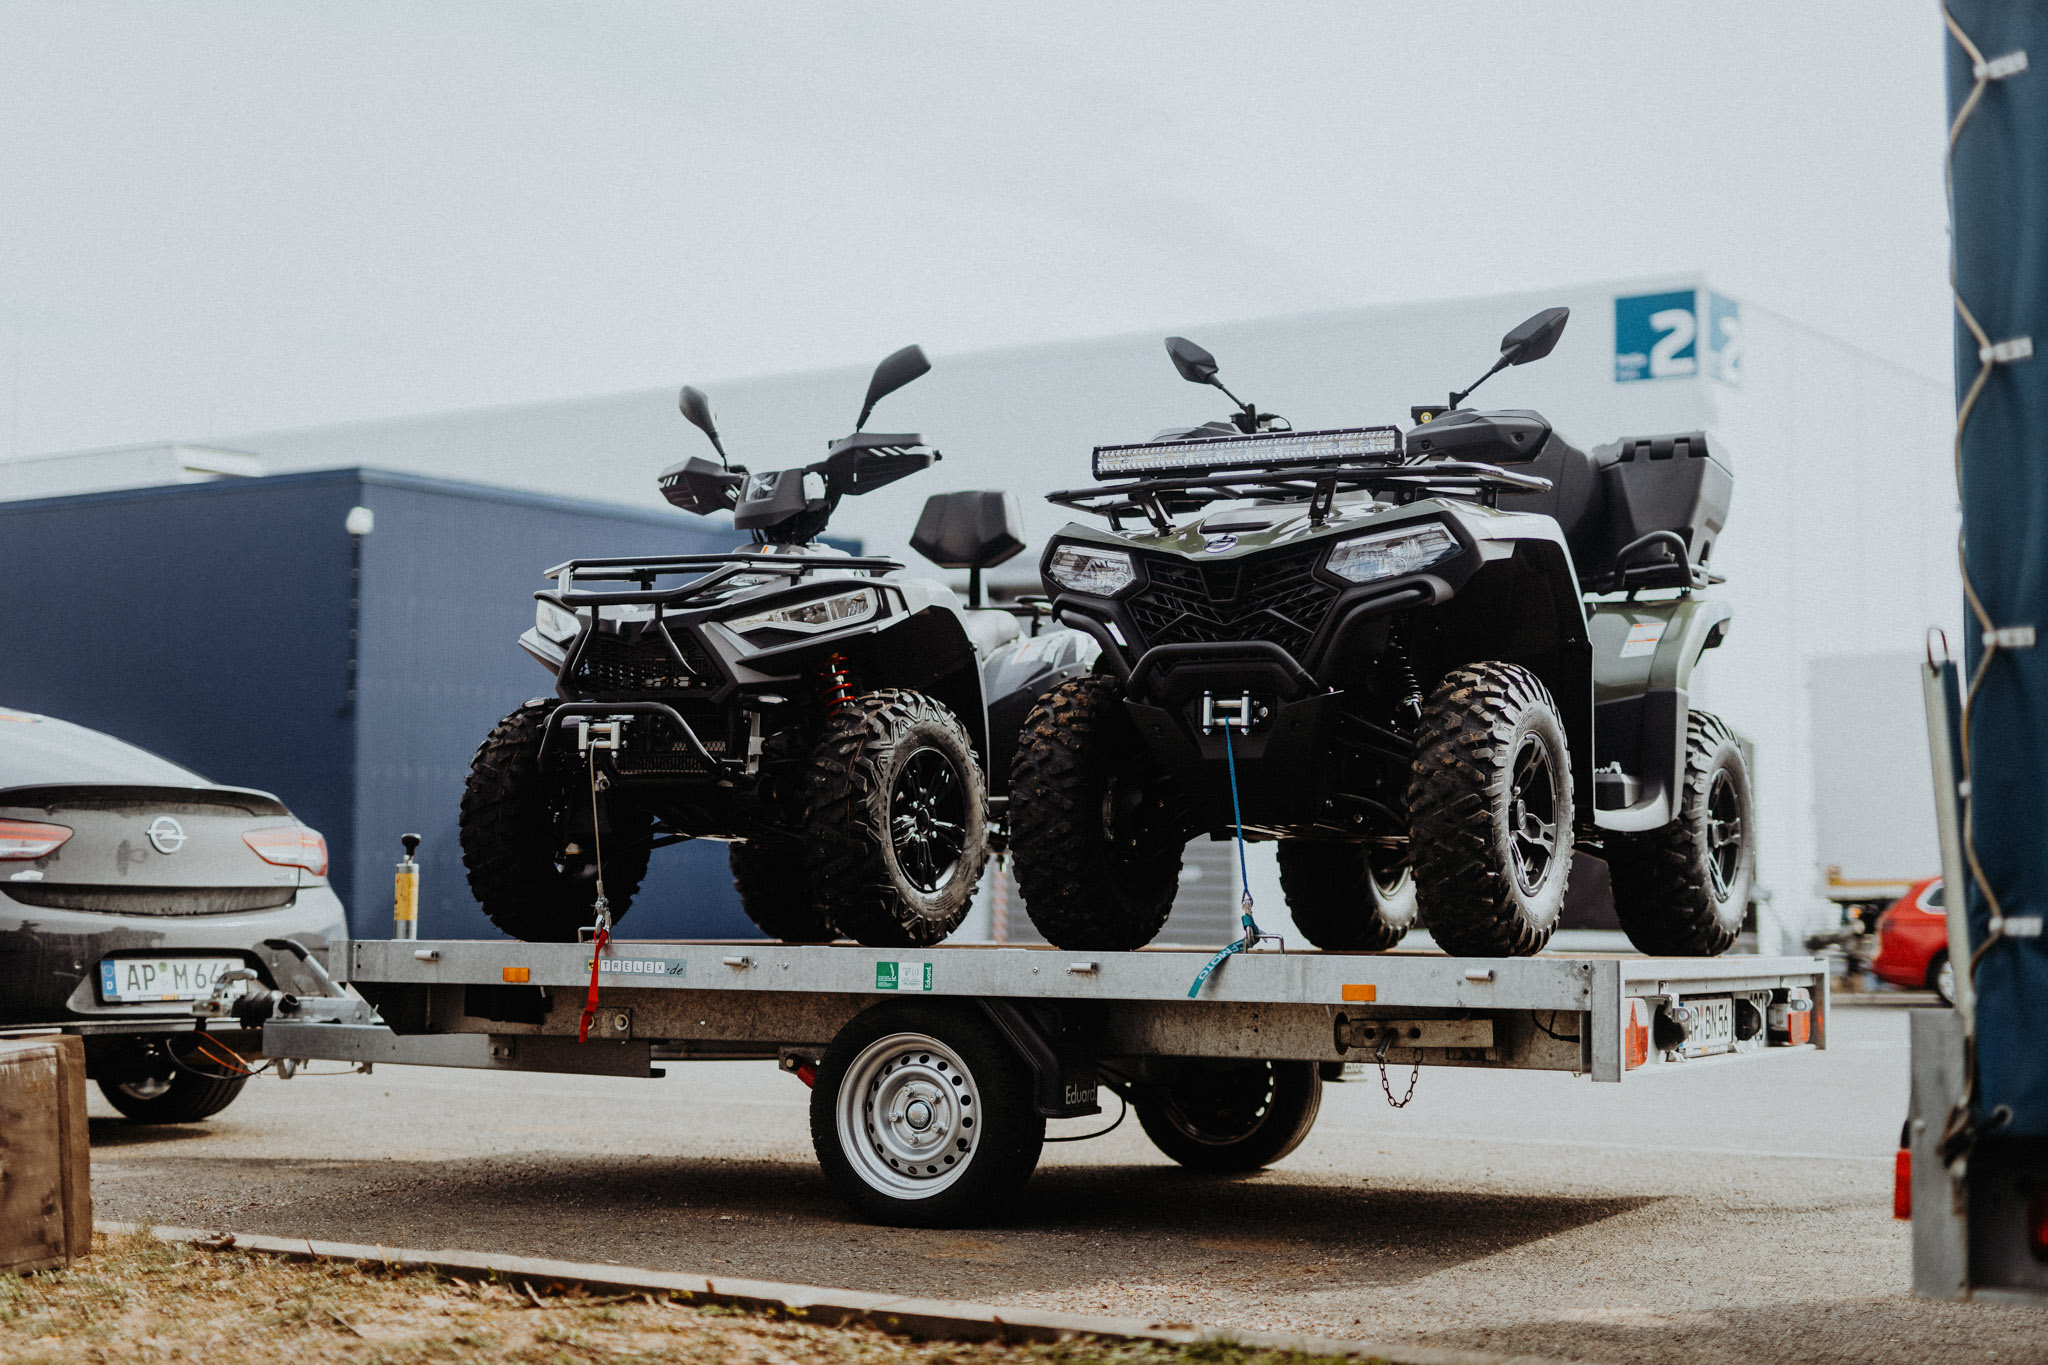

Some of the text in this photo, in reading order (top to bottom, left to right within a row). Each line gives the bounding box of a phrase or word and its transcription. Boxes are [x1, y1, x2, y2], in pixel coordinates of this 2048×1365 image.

[1649, 307, 1696, 377] 2
[127, 964, 156, 991] AP
[173, 963, 189, 990] M
